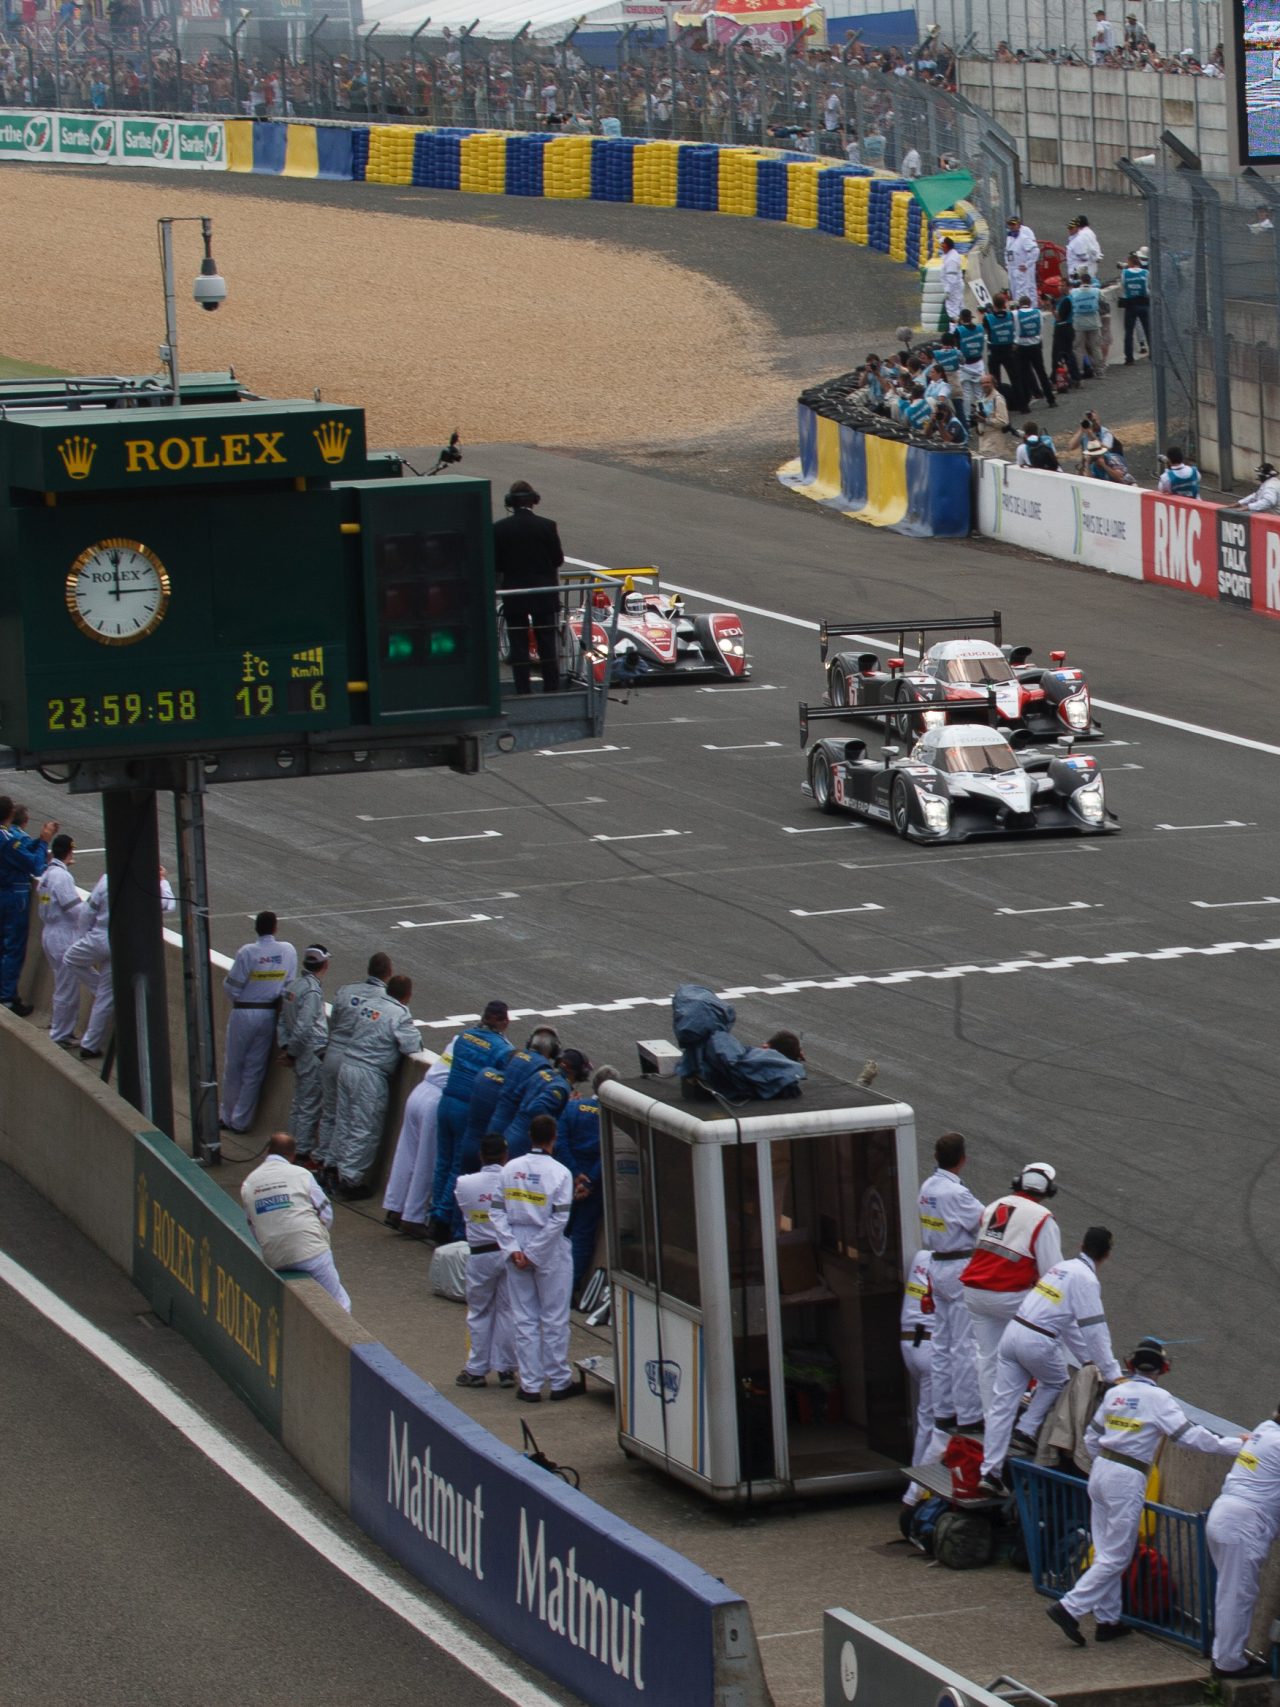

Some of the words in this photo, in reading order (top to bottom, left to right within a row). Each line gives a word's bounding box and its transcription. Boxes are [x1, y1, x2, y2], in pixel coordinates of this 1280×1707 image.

[61, 127, 90, 146] Sarthe
[125, 131, 152, 149] Sarthe
[124, 432, 288, 472] ROLEX
[1154, 501, 1202, 587] RMC
[1221, 520, 1246, 547] INFO
[1221, 547, 1248, 573] TALK
[92, 570, 142, 583] ROLEX
[1217, 570, 1252, 599] SPORT
[718, 628, 744, 637] TDI
[291, 664, 320, 678] Km/h
[48, 690, 196, 729] 23:59:58
[236, 685, 274, 716] 19
[310, 681, 326, 711] 6
[153, 1200, 195, 1295] ROLEX
[216, 1264, 262, 1366] ROLEX
[387, 1410, 485, 1581] Matmut
[515, 1506, 646, 1691] Matmut
